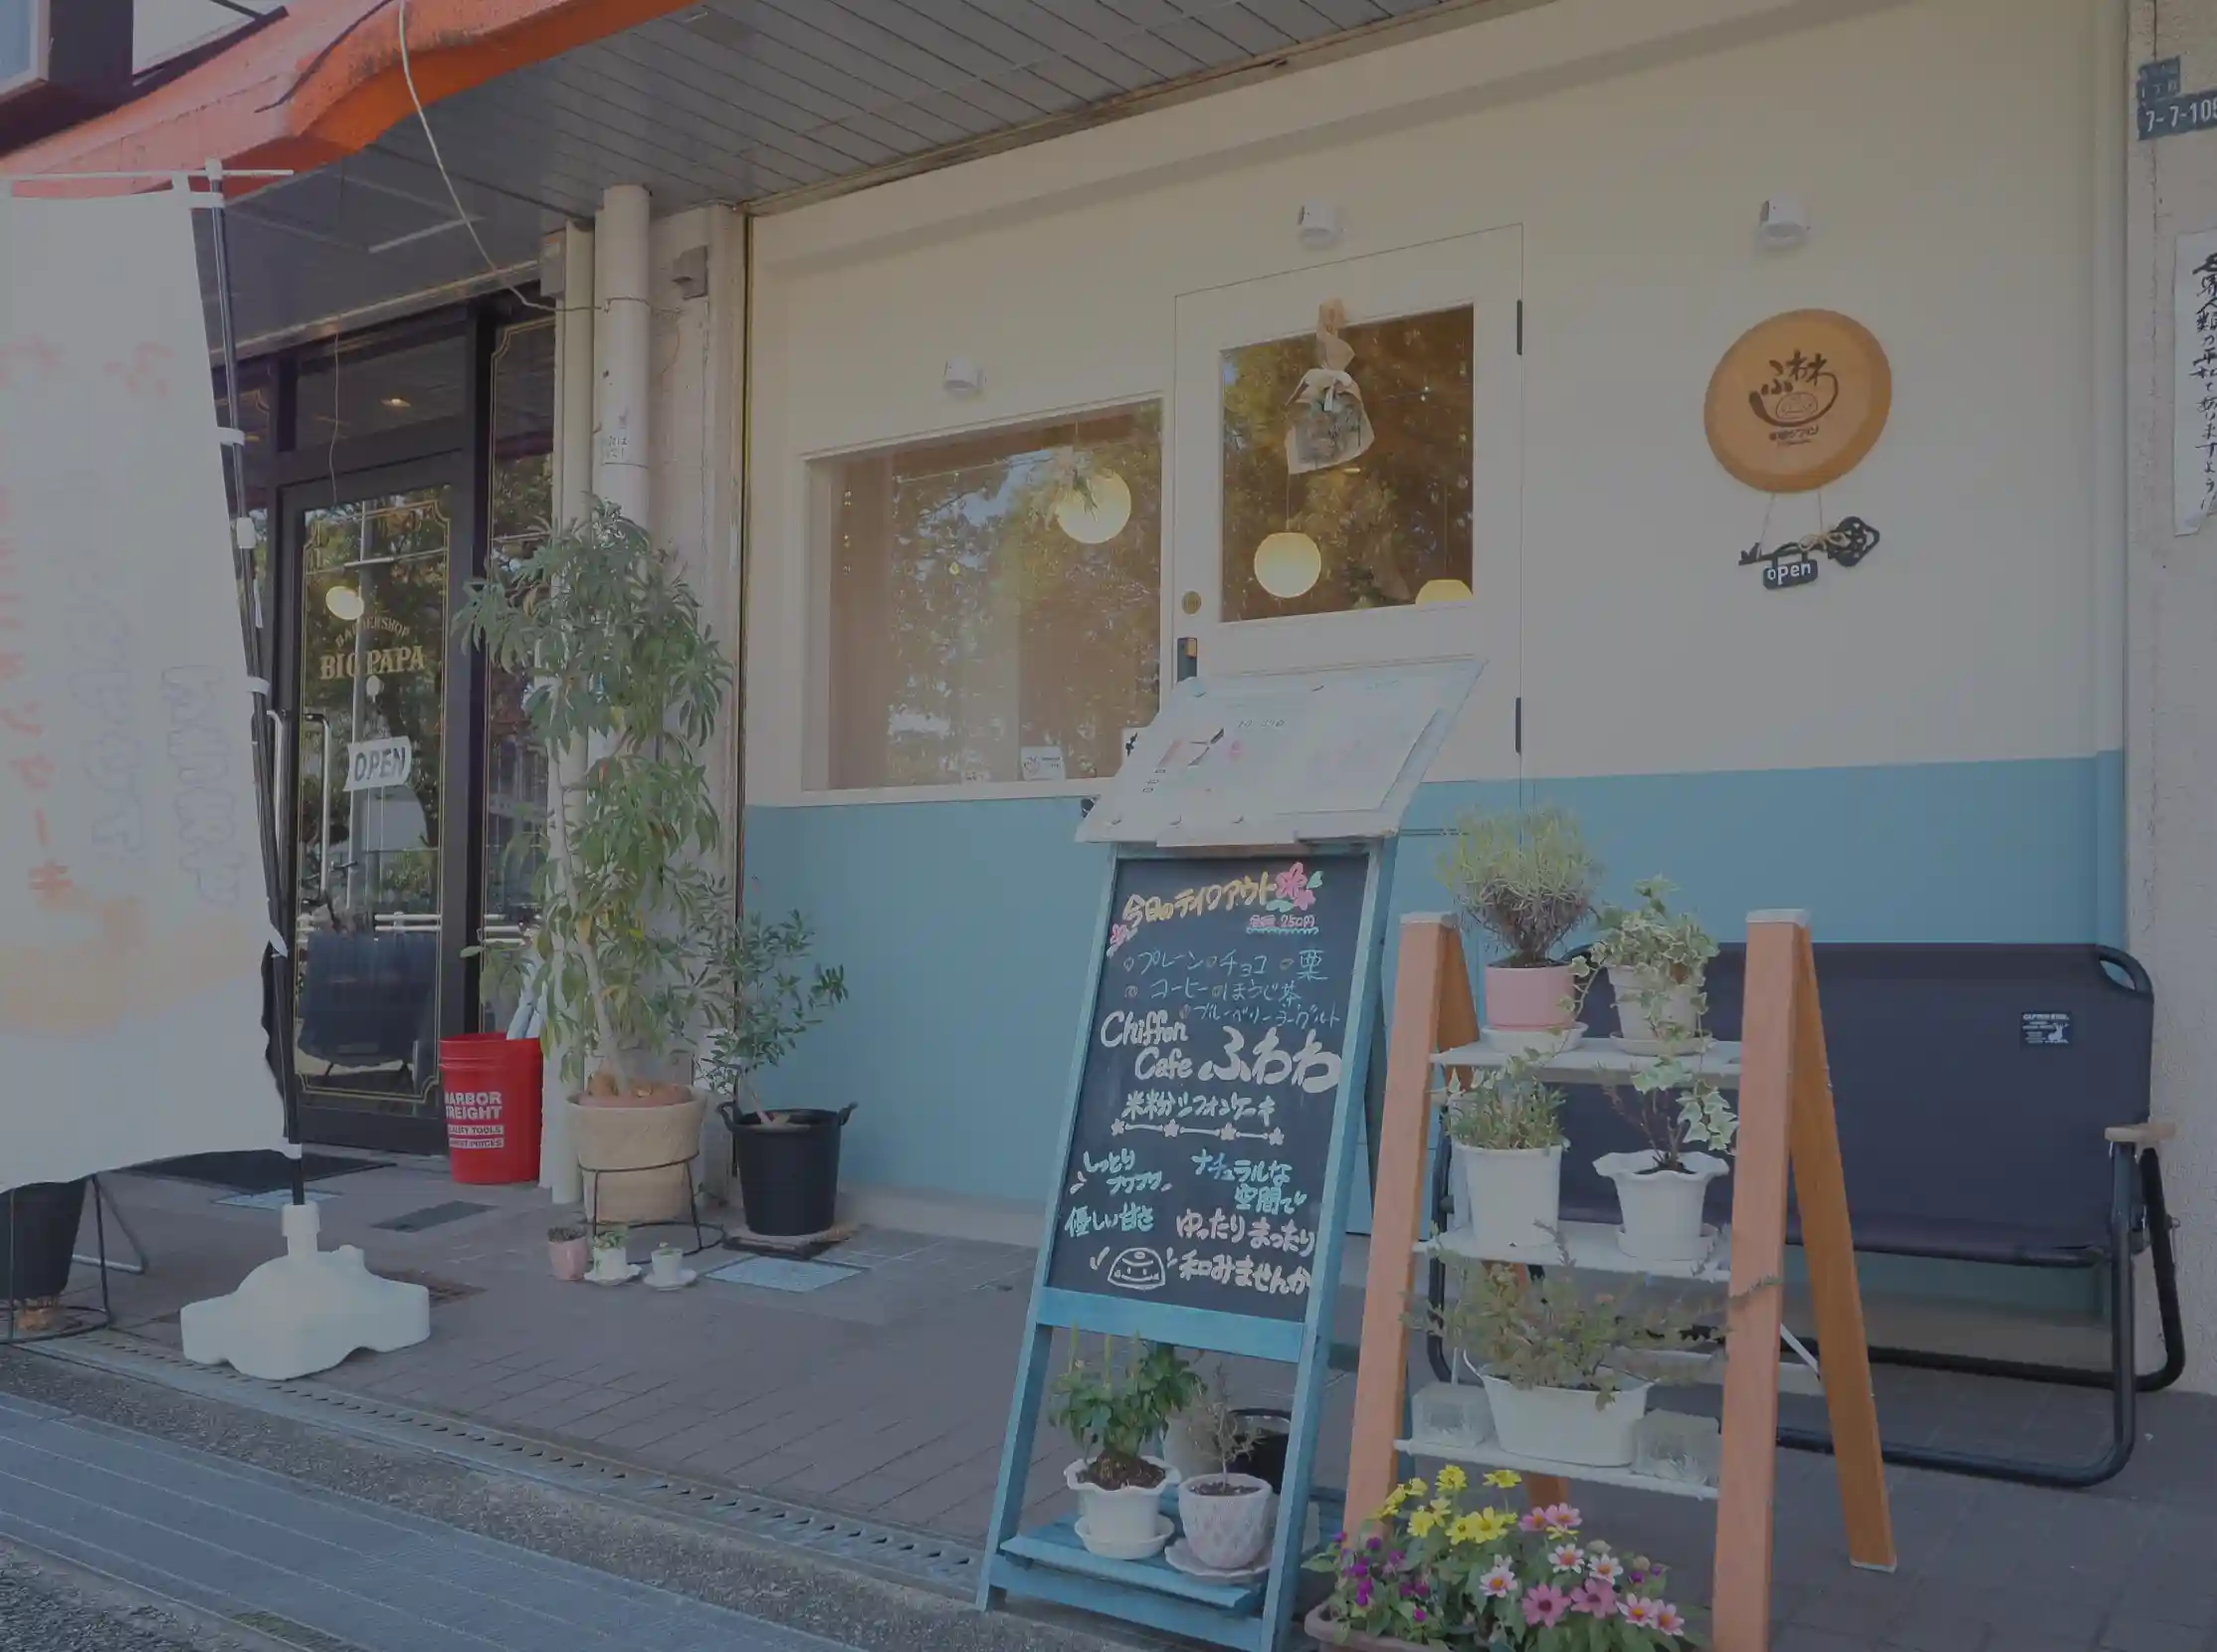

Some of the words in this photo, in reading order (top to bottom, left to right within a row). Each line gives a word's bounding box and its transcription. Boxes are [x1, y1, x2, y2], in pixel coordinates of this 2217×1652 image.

[1766, 562, 1812, 585] open
[365, 645, 427, 676] PAPA
[353, 746, 407, 782] OPEN
[1121, 871, 1278, 928] 今日のテイクアウト
[1137, 949, 1204, 976] プレーン
[1219, 948, 1269, 976] チョコ
[1297, 948, 1329, 980] 栗
[1150, 977, 1208, 999] コーヒー
[1222, 978, 1302, 1008] ほうじ茶
[1100, 1008, 1189, 1048] Chiffon
[1134, 1046, 1193, 1082] Cafe
[1197, 1025, 1342, 1094] ふわわ
[1120, 1089, 1277, 1128] 米粉シフォンケーキ
[1083, 1147, 1136, 1173] しっとり
[1190, 1147, 1293, 1184] ナチュラルな
[1064, 1201, 1155, 1238] 優しい甘さ
[1175, 1207, 1247, 1244] ゆったり
[1247, 1216, 1316, 1258] まったり
[1178, 1248, 1311, 1296] 和みませんか
